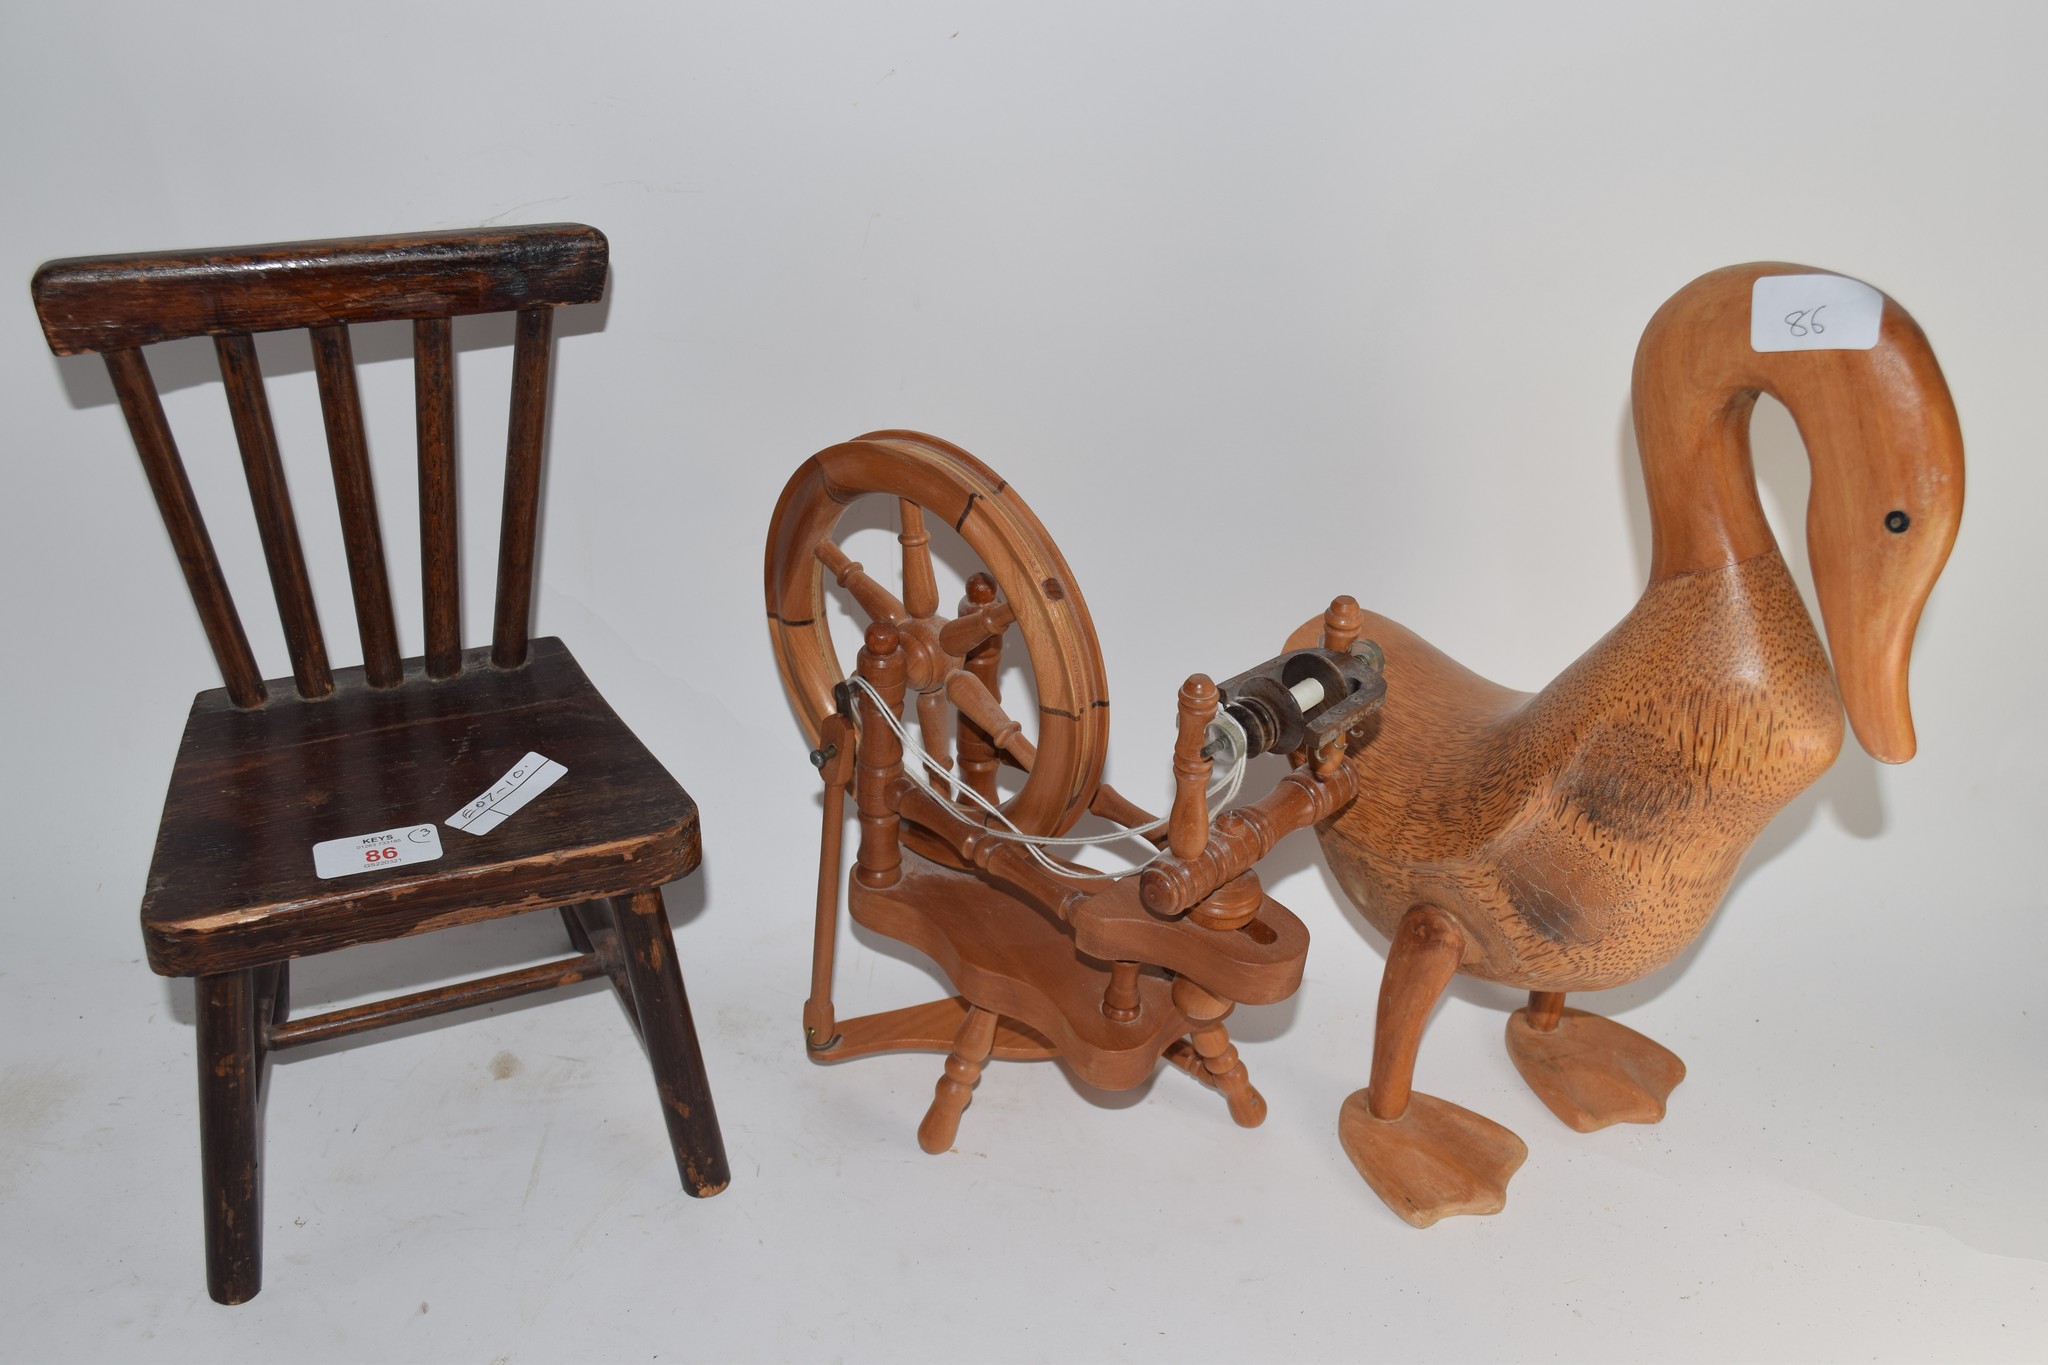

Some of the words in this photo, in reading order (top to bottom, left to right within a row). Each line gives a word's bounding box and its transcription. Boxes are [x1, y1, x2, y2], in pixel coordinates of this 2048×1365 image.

[1784, 305, 1827, 338] 86
[362, 834, 394, 845] KEYS
[365, 846, 398, 863] 86
